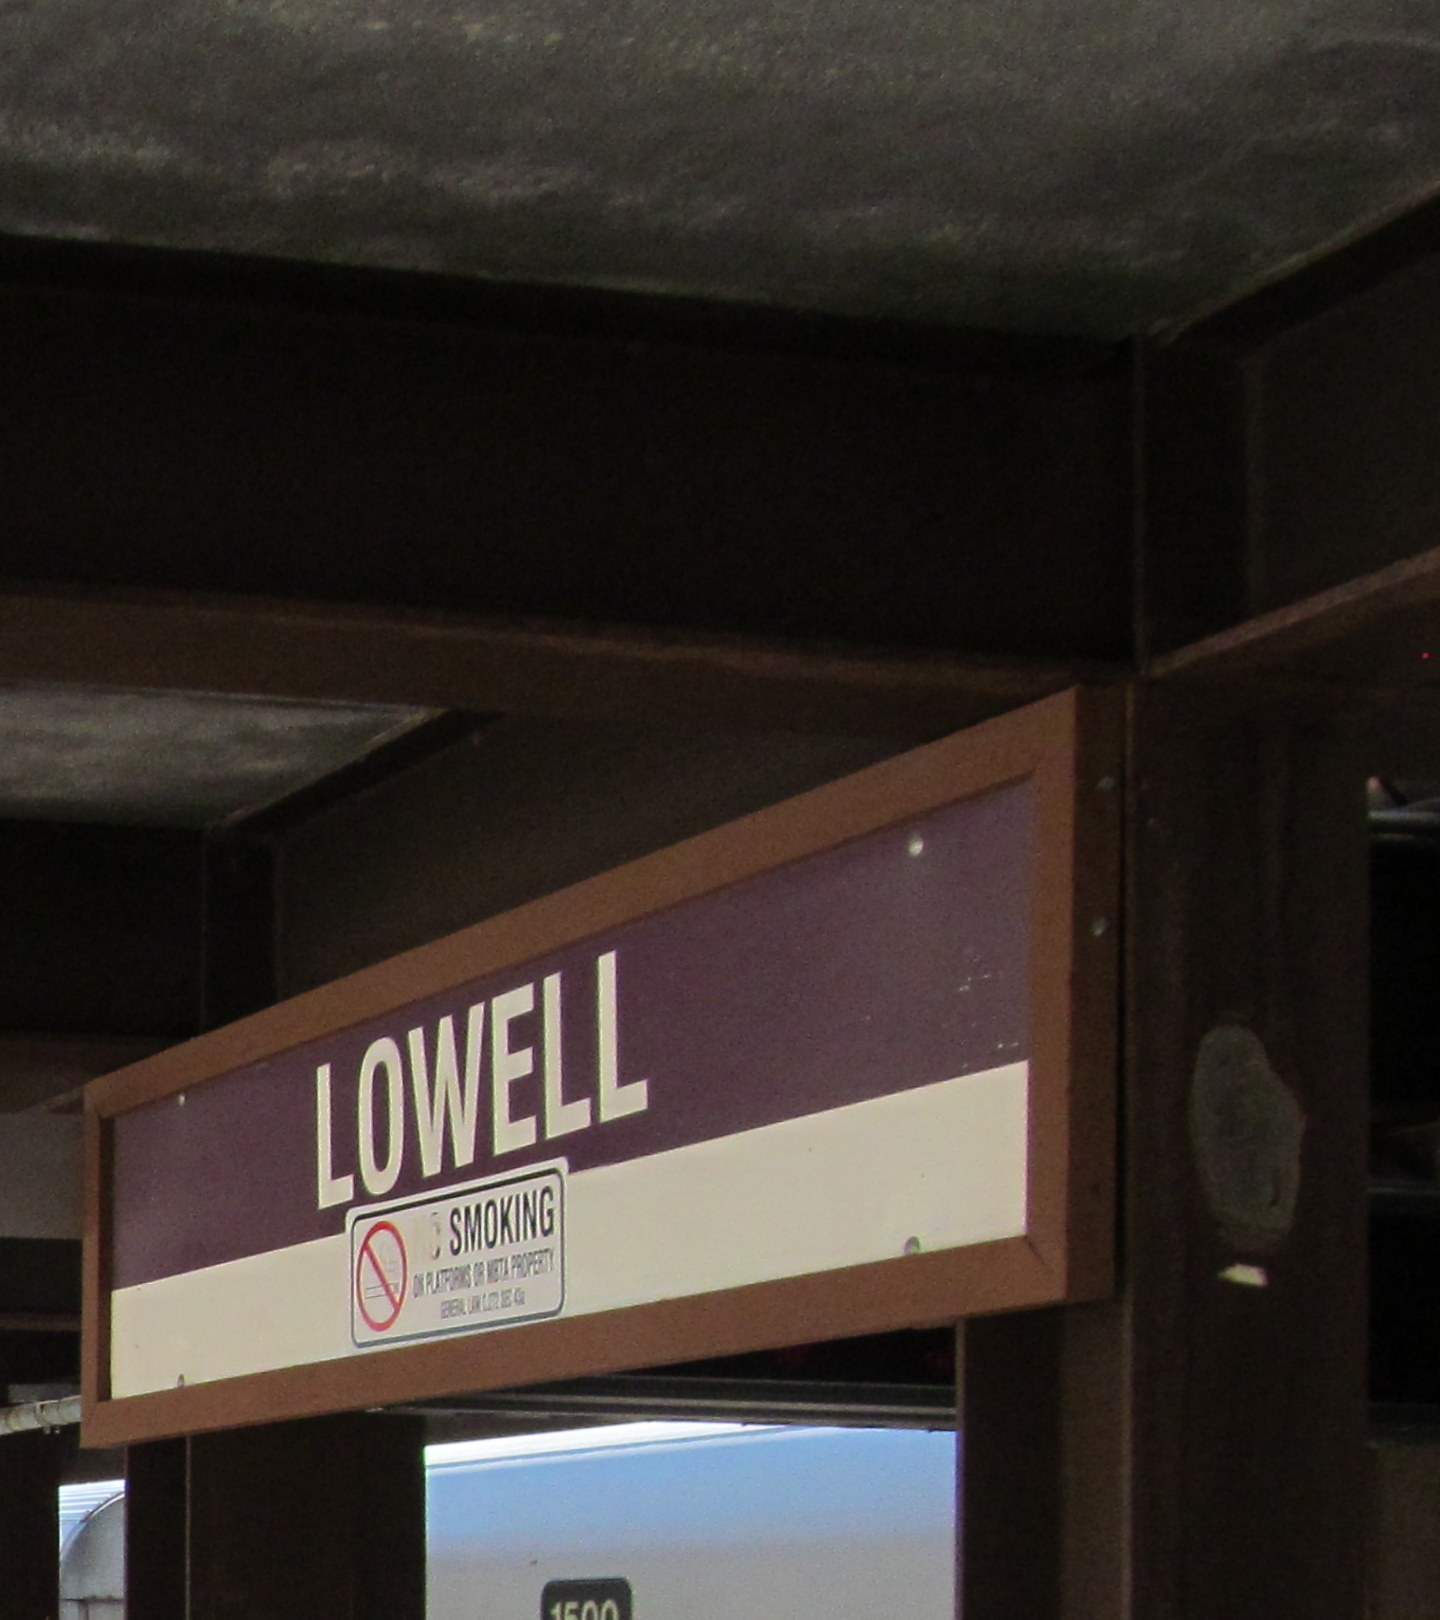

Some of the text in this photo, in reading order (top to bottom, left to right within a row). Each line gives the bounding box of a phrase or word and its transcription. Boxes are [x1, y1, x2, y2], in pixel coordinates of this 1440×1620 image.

[316, 949, 648, 1210] LOWELL
[449, 1185, 555, 1257] SMOKING
[426, 1264, 471, 1295] PLATFORMS
[486, 1256, 509, 1285] MBTA
[510, 1248, 554, 1280] PROPERTY
